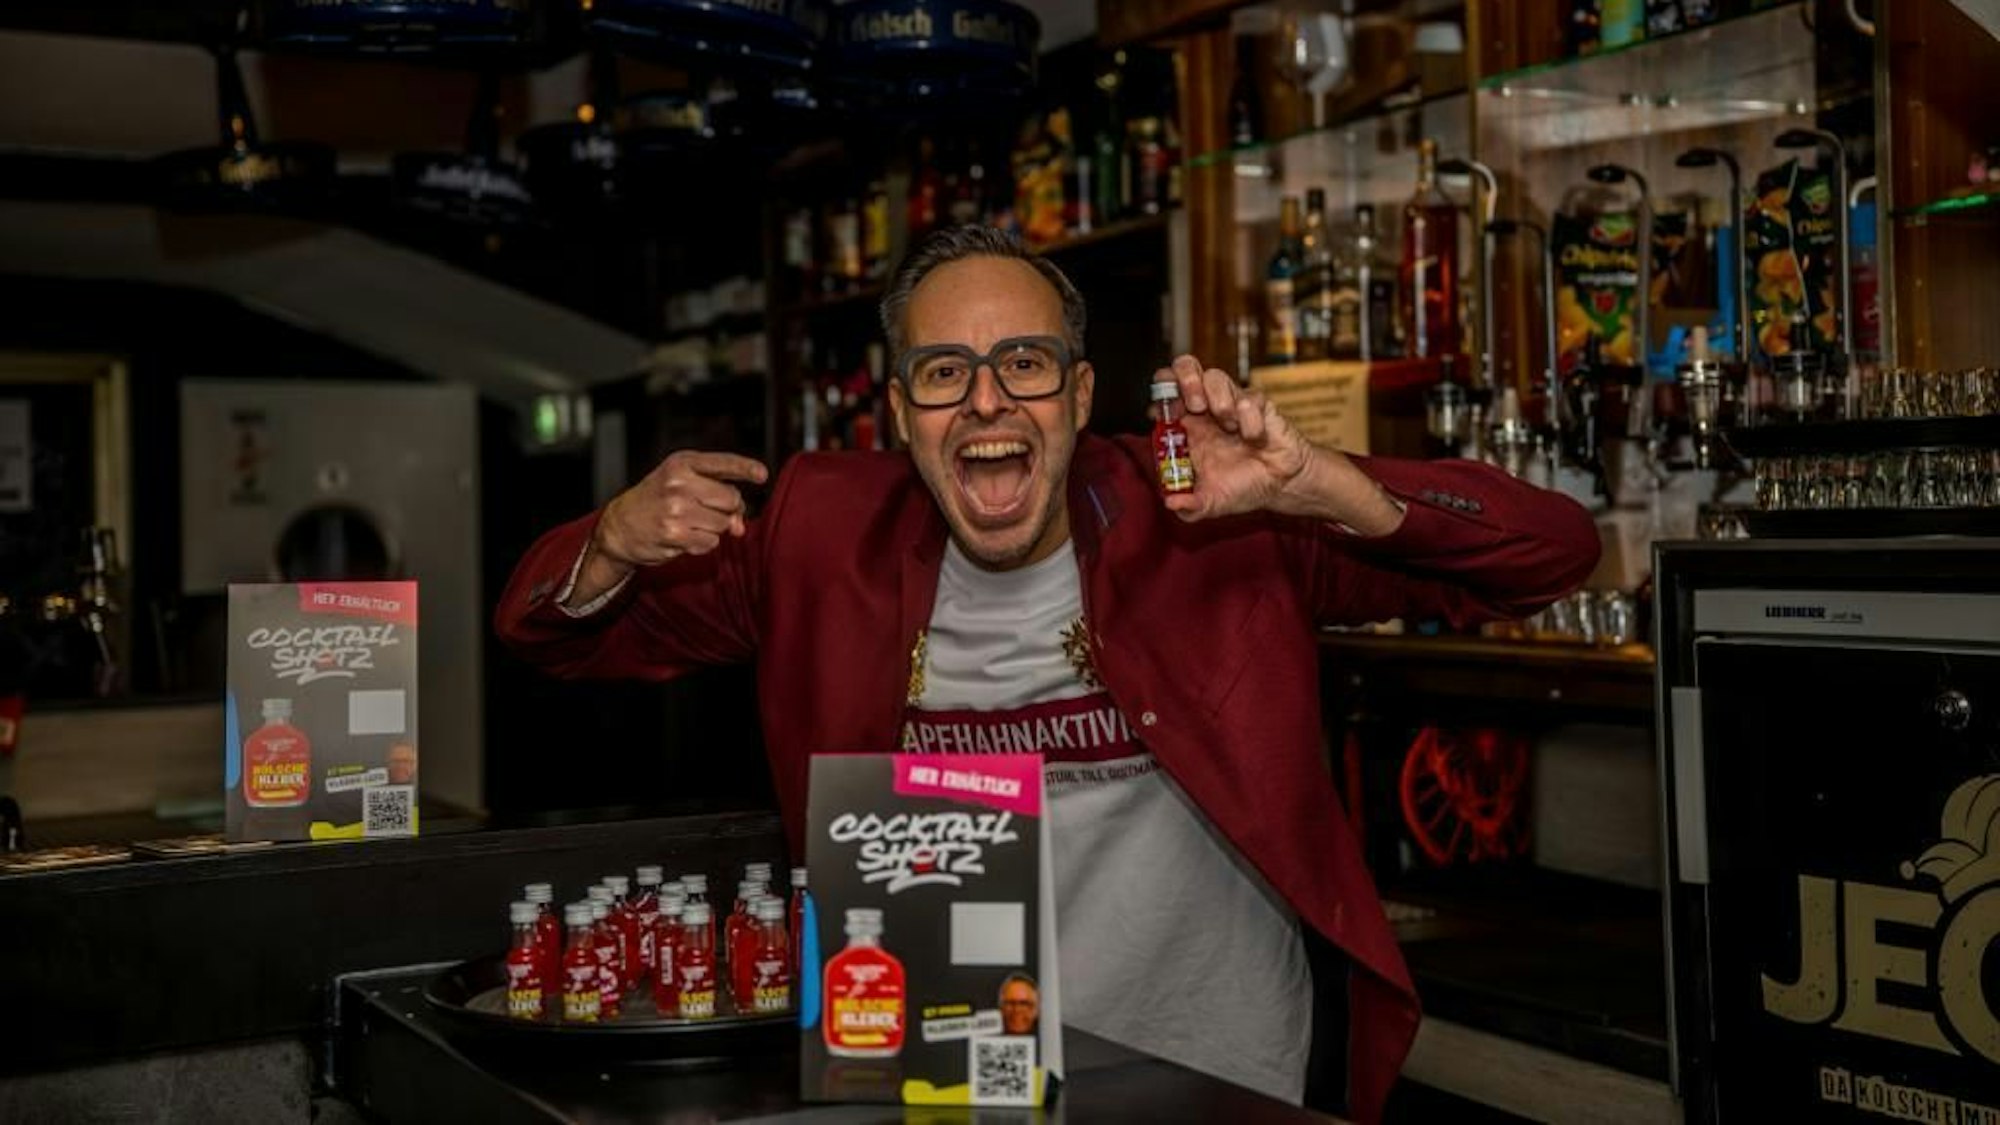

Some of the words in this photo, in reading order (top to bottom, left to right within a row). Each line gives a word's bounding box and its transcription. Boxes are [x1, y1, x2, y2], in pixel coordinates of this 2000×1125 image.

[246, 623, 401, 649] COCKTAIL
[270, 647, 375, 671] SHOTZ
[829, 811, 1019, 845] COCKTAIL
[856, 841, 985, 875] SHOTZ
